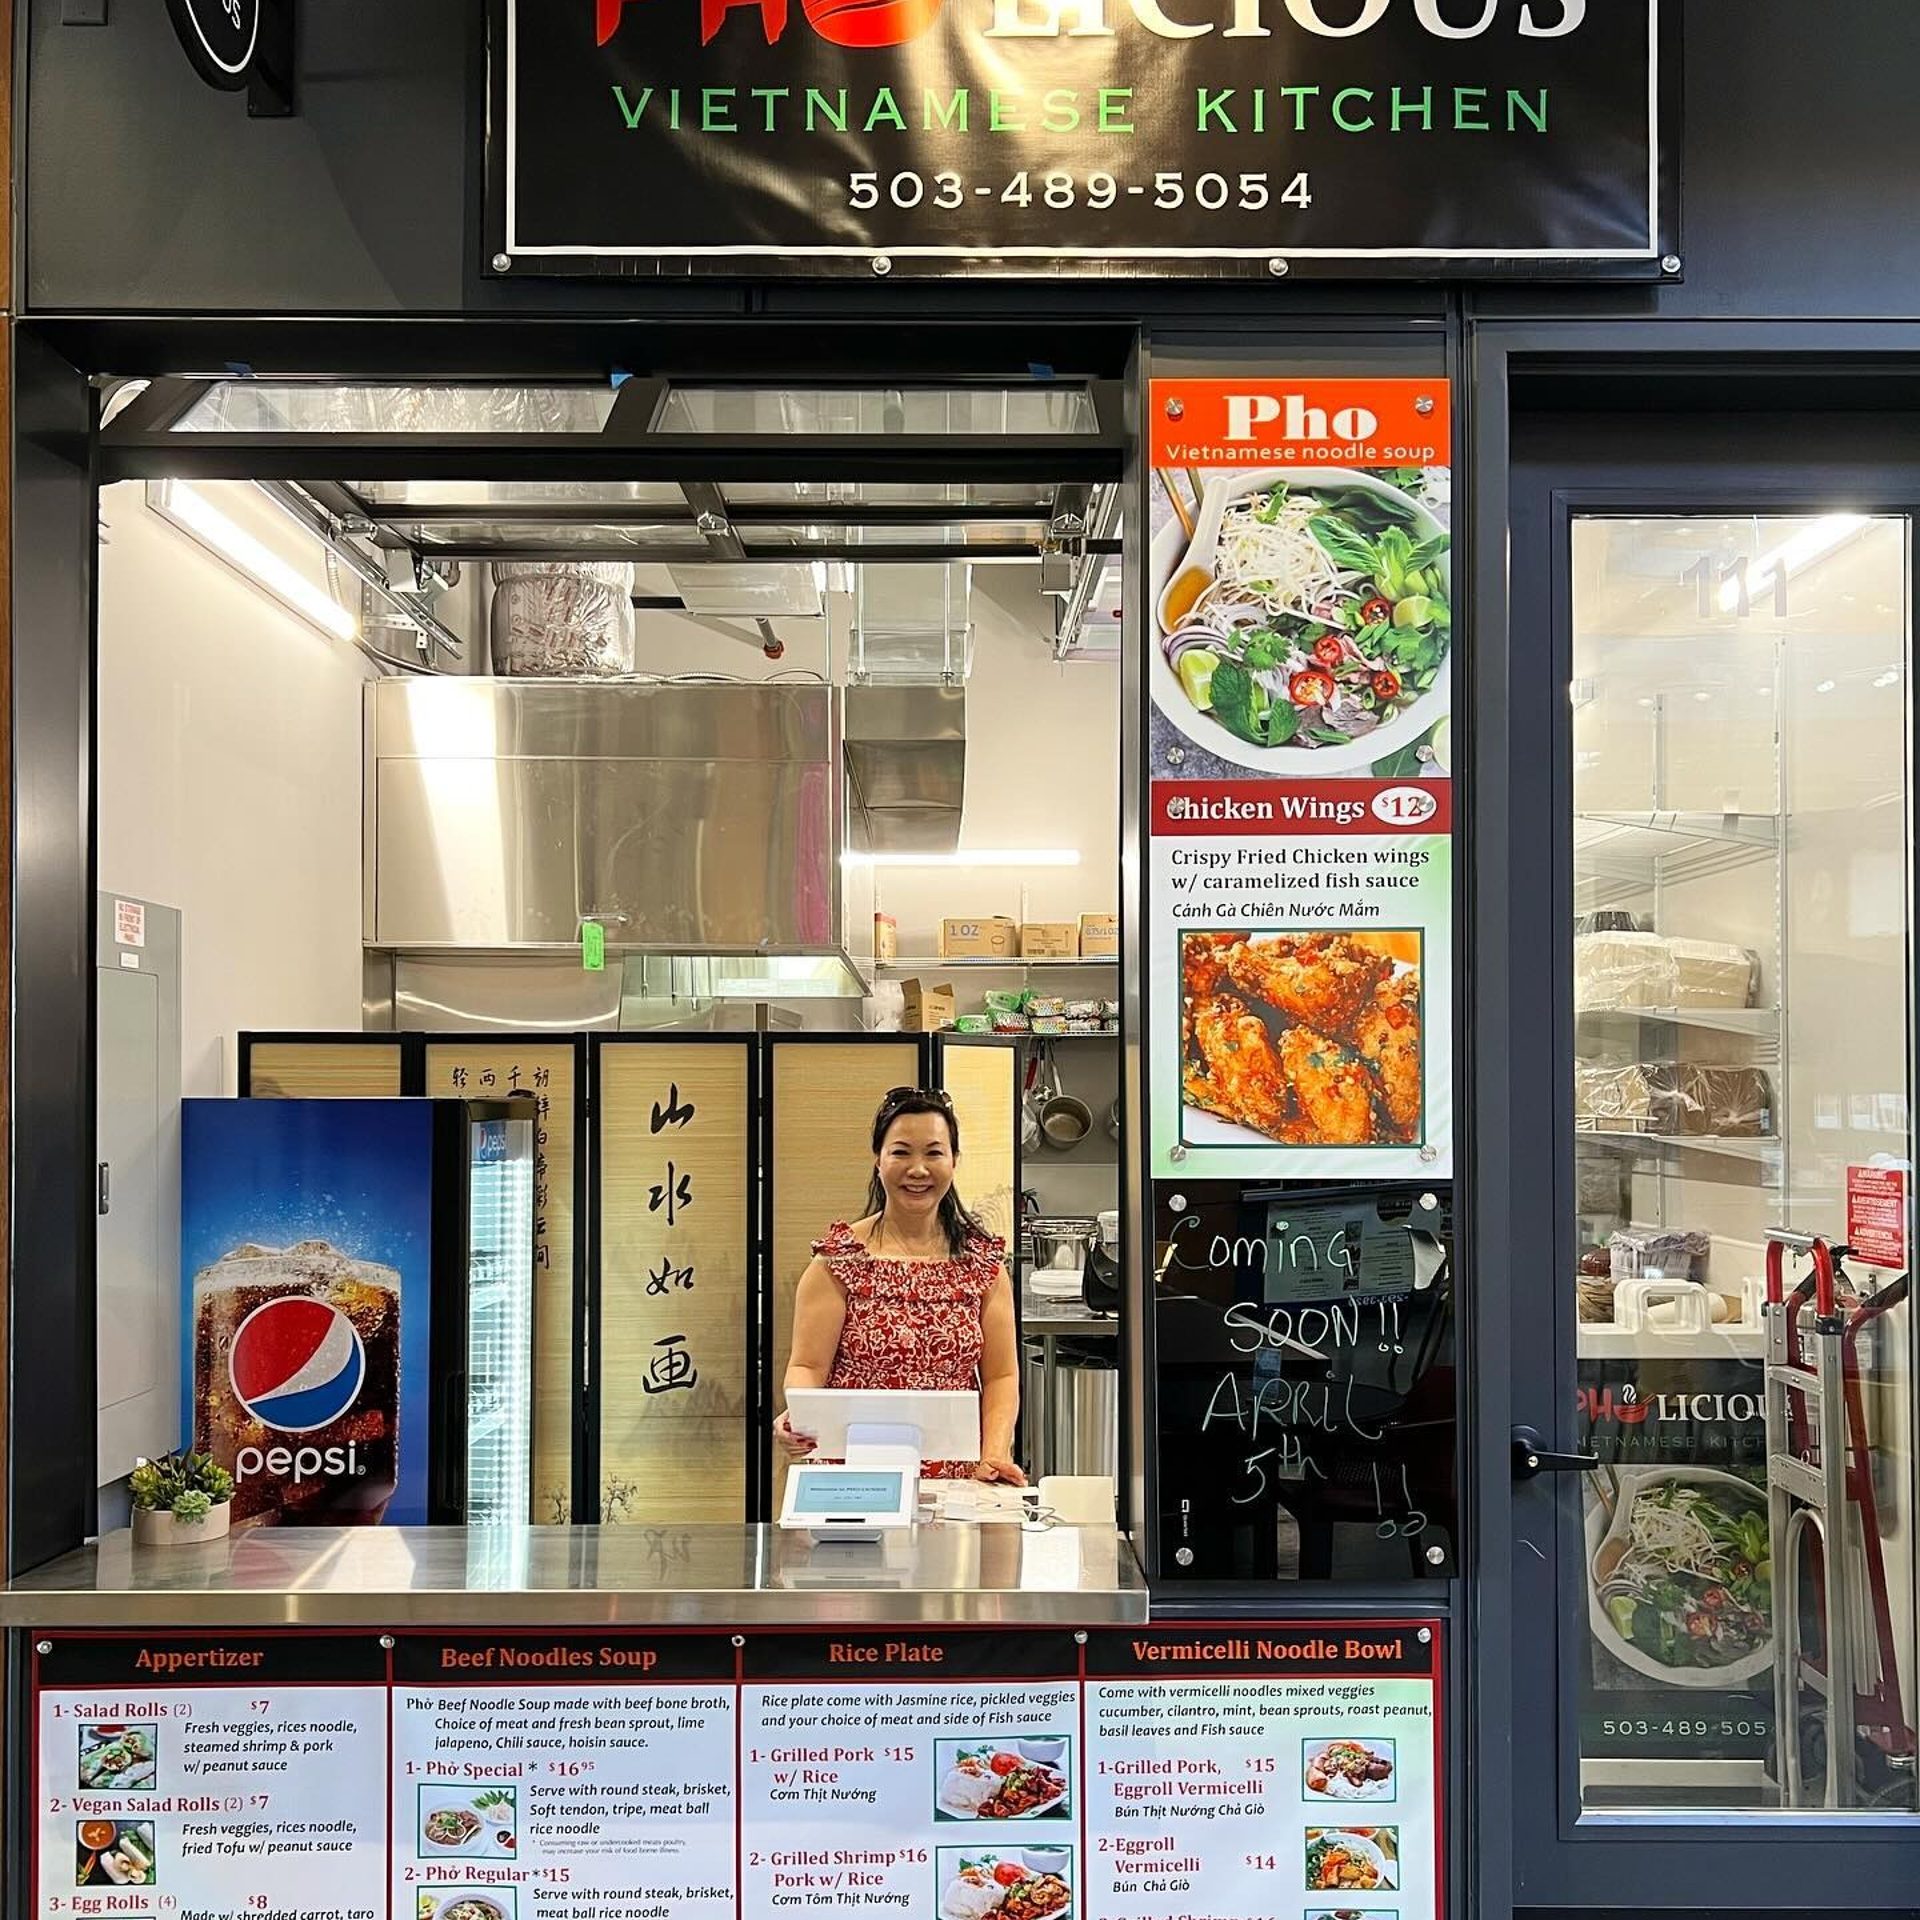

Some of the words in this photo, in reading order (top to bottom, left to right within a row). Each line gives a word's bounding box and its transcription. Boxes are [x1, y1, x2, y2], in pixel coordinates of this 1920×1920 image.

[612, 86, 1131, 132] VIETNAMESE
[1196, 86, 1548, 133] KITCHEN
[849, 171, 1312, 210] 503-489-5054
[1223, 394, 1378, 441] Pho
[1167, 445, 1295, 459] Vietnamese
[1303, 443, 1376, 459] noodle
[1384, 447, 1434, 462] soup
[1281, 797, 1364, 824] Wings
[1172, 850, 1231, 868] Crispy
[1238, 849, 1285, 864] Fried
[1293, 849, 1367, 863] Chicken
[1374, 849, 1429, 867] wings
[1172, 874, 1197, 892] w/
[1204, 873, 1319, 888] caramelized
[1327, 873, 1359, 887] fish
[1366, 877, 1419, 887] sauce
[1216, 903, 1236, 917] Gà
[830, 1644, 877, 1661] Rice
[886, 1643, 943, 1661] Plate
[1133, 1640, 1249, 1660] Vermicelli
[1257, 1640, 1338, 1659] Noodle
[1345, 1640, 1401, 1658] Bowl
[136, 1649, 263, 1672] Appertizer
[442, 1648, 495, 1667] Beef
[500, 1648, 593, 1666] Noodles
[600, 1648, 656, 1670] Soup
[439, 1699, 467, 1713] Beef
[470, 1699, 515, 1710] Noodle
[518, 1699, 550, 1712] Soup
[554, 1698, 589, 1709] made
[593, 1698, 621, 1709] with
[625, 1697, 653, 1712] beef
[656, 1697, 687, 1708] bone
[691, 1697, 729, 1710] broth,
[762, 1695, 788, 1706] Rice
[791, 1695, 823, 1709] plate
[827, 1697, 860, 1706] come
[865, 1694, 892, 1705] with
[896, 1694, 947, 1705] Jasmine
[951, 1694, 976, 1706] rice,
[981, 1693, 1025, 1708] pickled
[1029, 1691, 1075, 1706] veggies
[74, 1704, 119, 1717] Salad
[126, 1703, 167, 1717] Rolls
[174, 1704, 191, 1717] (2)
[252, 1701, 269, 1714] $7
[1100, 1705, 1163, 1718] cucumber,
[1168, 1705, 1219, 1717] cilantro,
[1223, 1704, 1255, 1716] mint,
[1260, 1704, 1289, 1715] bean
[1294, 1705, 1343, 1718] sprouts,
[1348, 1705, 1379, 1715] roast
[1383, 1702, 1432, 1719] peanut,
[185, 1722, 219, 1733] Fresh
[223, 1721, 273, 1736] veggies,
[278, 1721, 306, 1732] rices
[310, 1720, 356, 1733] noodle,
[1603, 1720, 1775, 1737] 503-489-505
[184, 1741, 239, 1753] steamed
[243, 1740, 287, 1754] shrimp
[290, 1740, 299, 1751] &
[304, 1740, 333, 1754] pork
[771, 1748, 828, 1761] Grilled
[835, 1748, 873, 1761] Pork
[885, 1748, 913, 1760] $15
[464, 1763, 522, 1779] Special
[1178, 1760, 1220, 1774] Pork,
[1246, 1759, 1274, 1772] $15
[774, 1770, 797, 1787] w/
[804, 1770, 838, 1783] Rice
[530, 1785, 565, 1796] Serve
[569, 1784, 597, 1795] with
[601, 1784, 639, 1795] round
[642, 1784, 679, 1797] steak,
[684, 1784, 730, 1796] brisket,
[1115, 1782, 1172, 1800] Eggroll
[1178, 1780, 1262, 1795] Vermicelli
[73, 1798, 121, 1815] Vegan
[128, 1798, 171, 1811] Salad
[178, 1797, 219, 1811] Rolls
[225, 1797, 242, 1811] (2)
[251, 1796, 268, 1809] $7
[1116, 1806, 1139, 1817] Bún
[1245, 1804, 1264, 1815] Giò
[771, 1851, 828, 1865] Grilled
[834, 1851, 895, 1867] Shrimp
[900, 1849, 927, 1862] $16
[1116, 1854, 1199, 1873] Vermicelli
[1247, 1856, 1275, 1869] $14
[466, 1867, 529, 1883] Regular
[543, 1868, 570, 1882] $15
[775, 1873, 814, 1886] Pork
[820, 1872, 842, 1889] w/
[849, 1872, 883, 1885] Rice
[1113, 1881, 1136, 1892] Bún
[1170, 1880, 1189, 1891] Giò
[72, 1896, 103, 1913] Egg
[106, 1896, 149, 1910] Rolls
[158, 1896, 177, 1909] (4)
[248, 1896, 268, 1909] $8
[806, 1893, 832, 1904] Tôm
